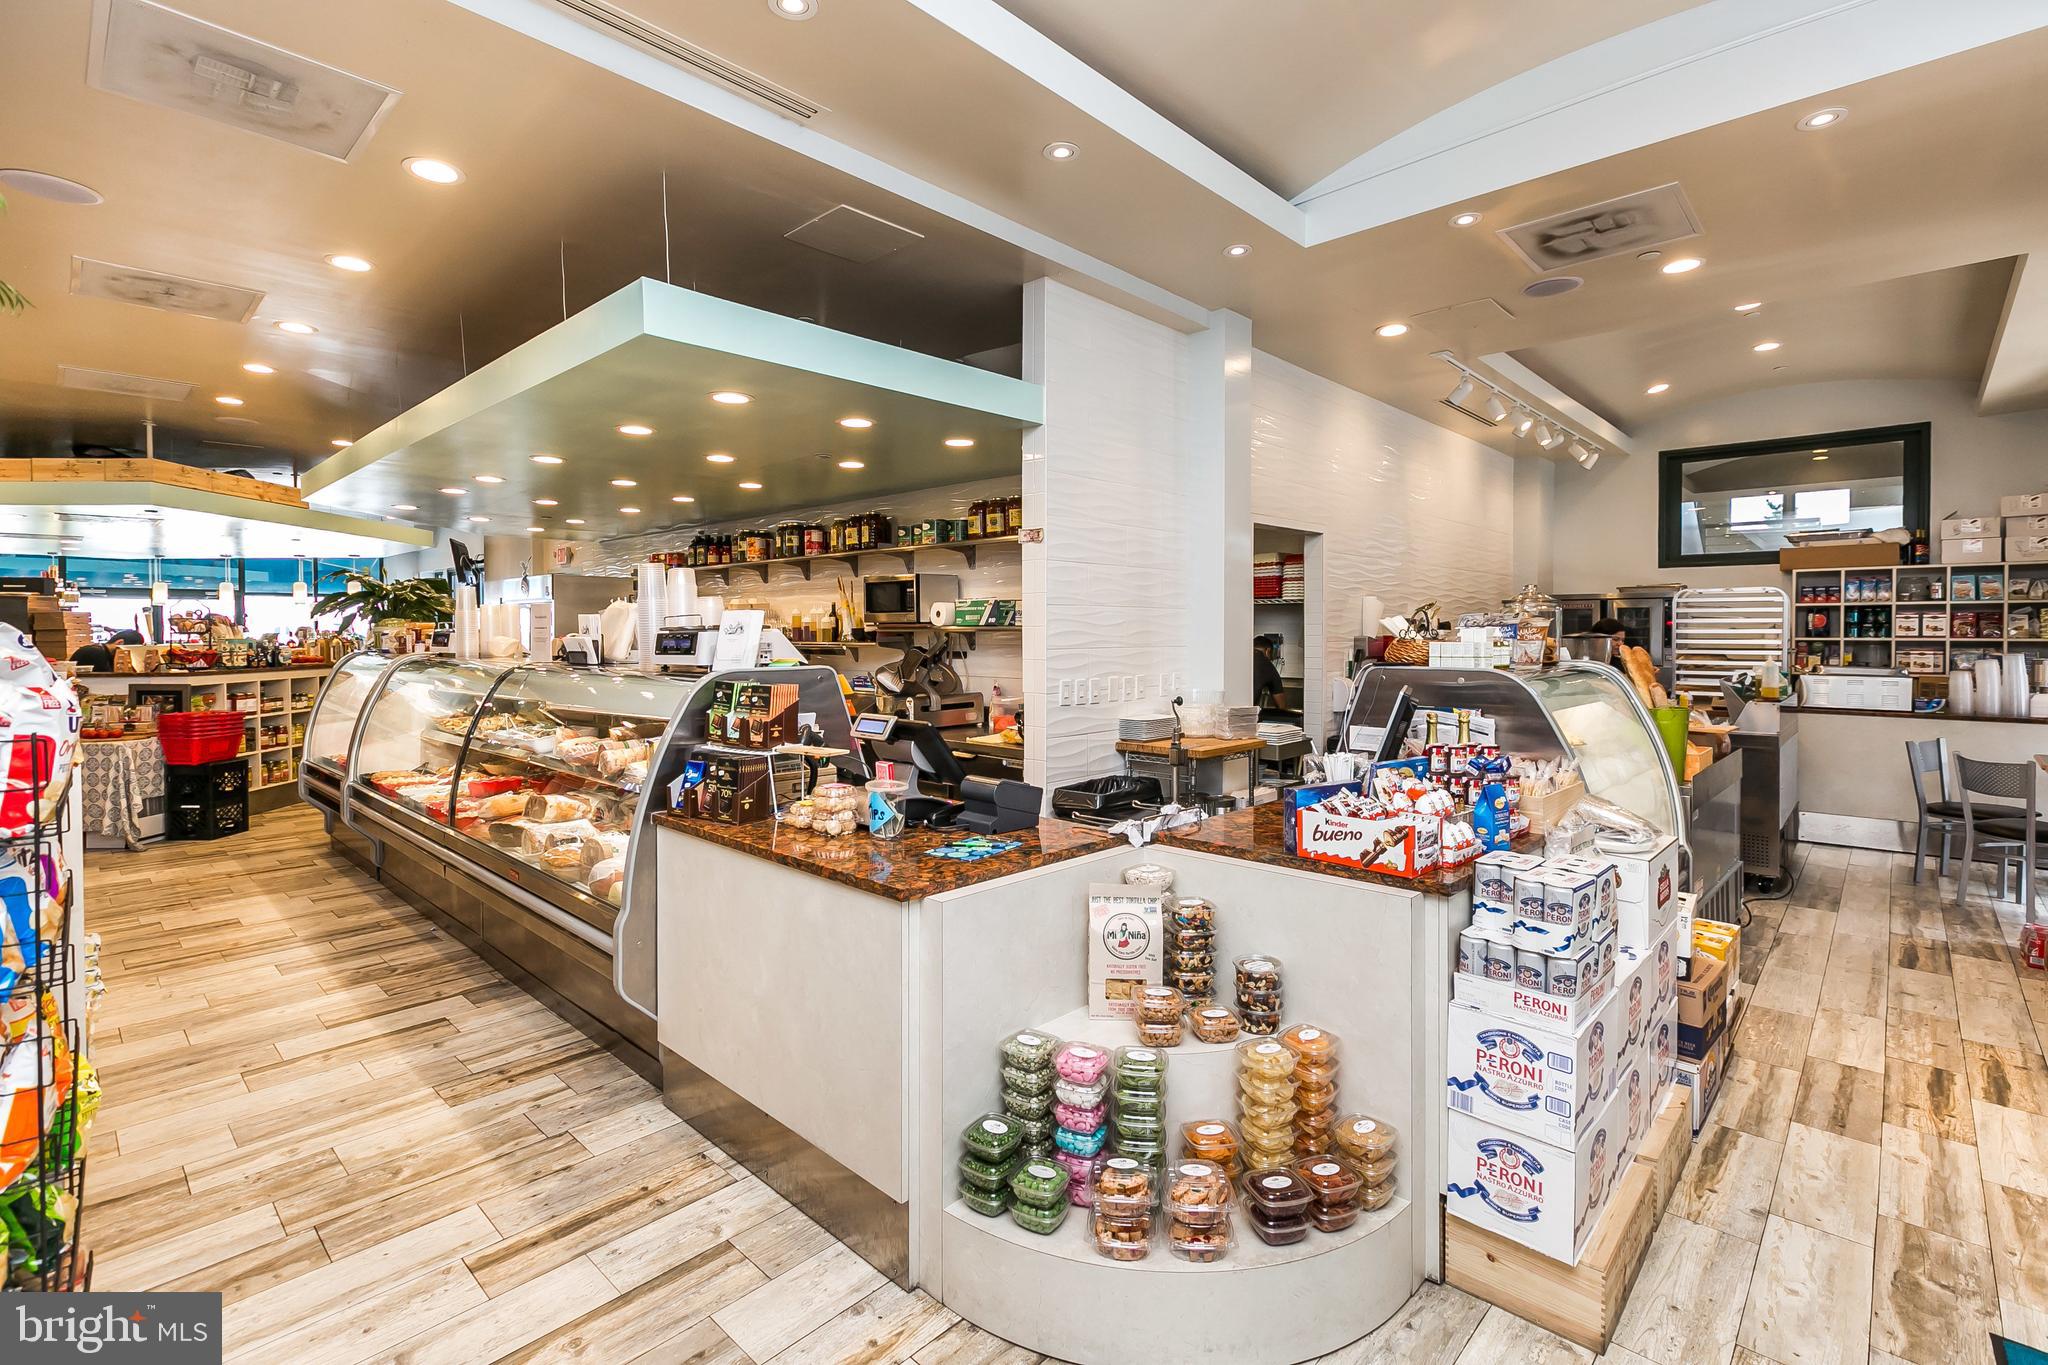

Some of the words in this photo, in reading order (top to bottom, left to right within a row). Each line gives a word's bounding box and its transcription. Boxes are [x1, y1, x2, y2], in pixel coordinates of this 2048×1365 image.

[1325, 818, 1349, 829] Kinder
[1312, 824, 1363, 842] bueno
[1091, 896, 1101, 904] JUST
[1103, 896, 1112, 904] THE
[1107, 931, 1117, 939] Mi
[1128, 930, 1146, 939] Niña
[1513, 991, 1568, 1016] PERONI
[1514, 1003, 1538, 1015] NASTRO
[1538, 1010, 1568, 1022] AZZURRO
[1476, 1048, 1543, 1083] PERONI
[1476, 1064, 1506, 1080] NASTRO
[1507, 1074, 1544, 1091] AZZURRO
[1554, 1079, 1573, 1090] BOTTLE
[1554, 1086, 1568, 1094] CODE
[1558, 1117, 1571, 1125] CASE
[1558, 1123, 1571, 1131] CODE
[1476, 1156, 1543, 1196] PERONI
[1476, 1171, 1506, 1188] NASTRO
[1507, 1185, 1544, 1204] AZZURRO
